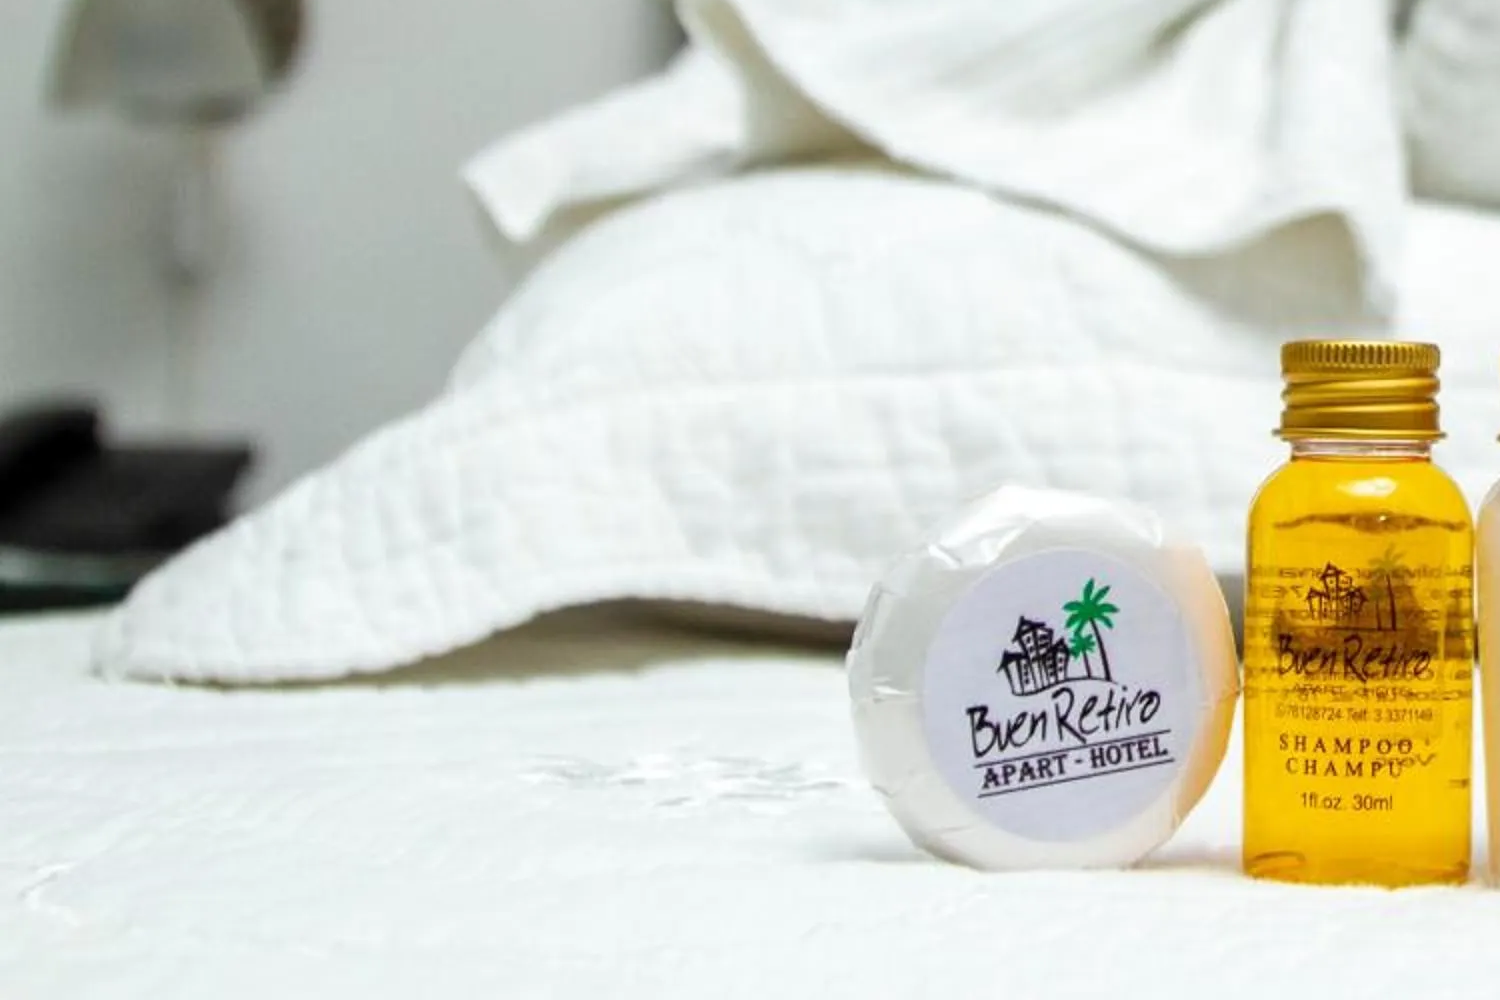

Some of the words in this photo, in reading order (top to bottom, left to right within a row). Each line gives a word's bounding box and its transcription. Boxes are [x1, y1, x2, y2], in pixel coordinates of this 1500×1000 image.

[1279, 733, 1413, 755] SHAMPOO
[981, 753, 1068, 790] APART
[1090, 737, 1168, 769] HOTEL
[1353, 793, 1393, 811] 30ml
